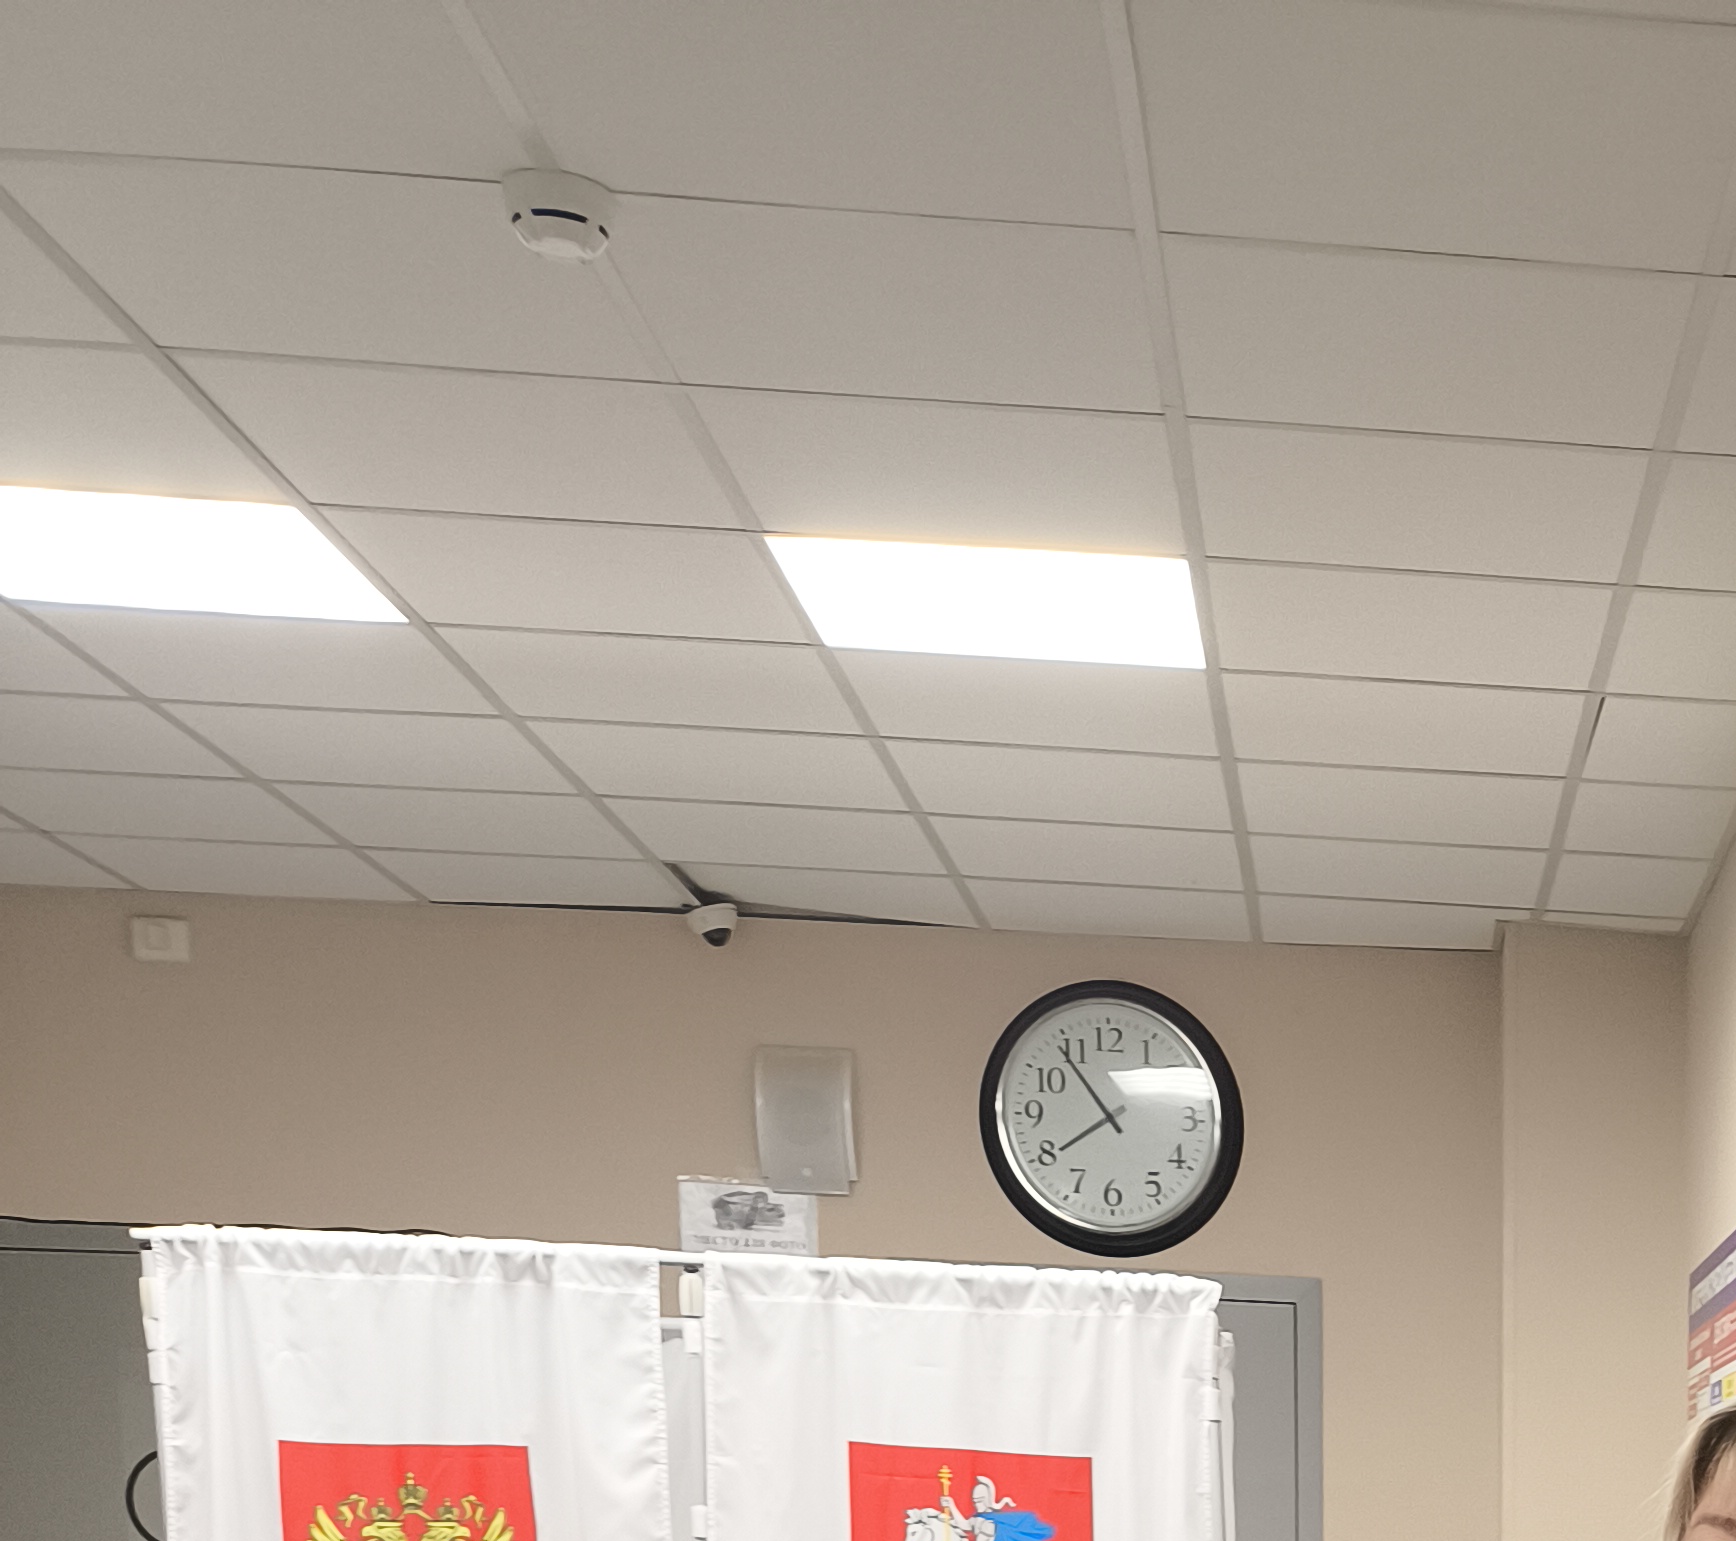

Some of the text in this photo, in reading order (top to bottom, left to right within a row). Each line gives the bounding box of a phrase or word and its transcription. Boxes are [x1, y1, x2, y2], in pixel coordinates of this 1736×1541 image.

[1062, 1037, 1088, 1064] 11
[1094, 1026, 1125, 1054] 12
[1142, 1039, 1152, 1065] 1
[1036, 1066, 1067, 1094] 10
[1024, 1099, 1045, 1129] 9
[1181, 1106, 1199, 1132] 3
[1037, 1139, 1058, 1167] 8
[1167, 1143, 1187, 1170] 4
[1069, 1168, 1087, 1194] 7
[1103, 1178, 1123, 1207] 6
[1144, 1171, 1162, 1198] 5
